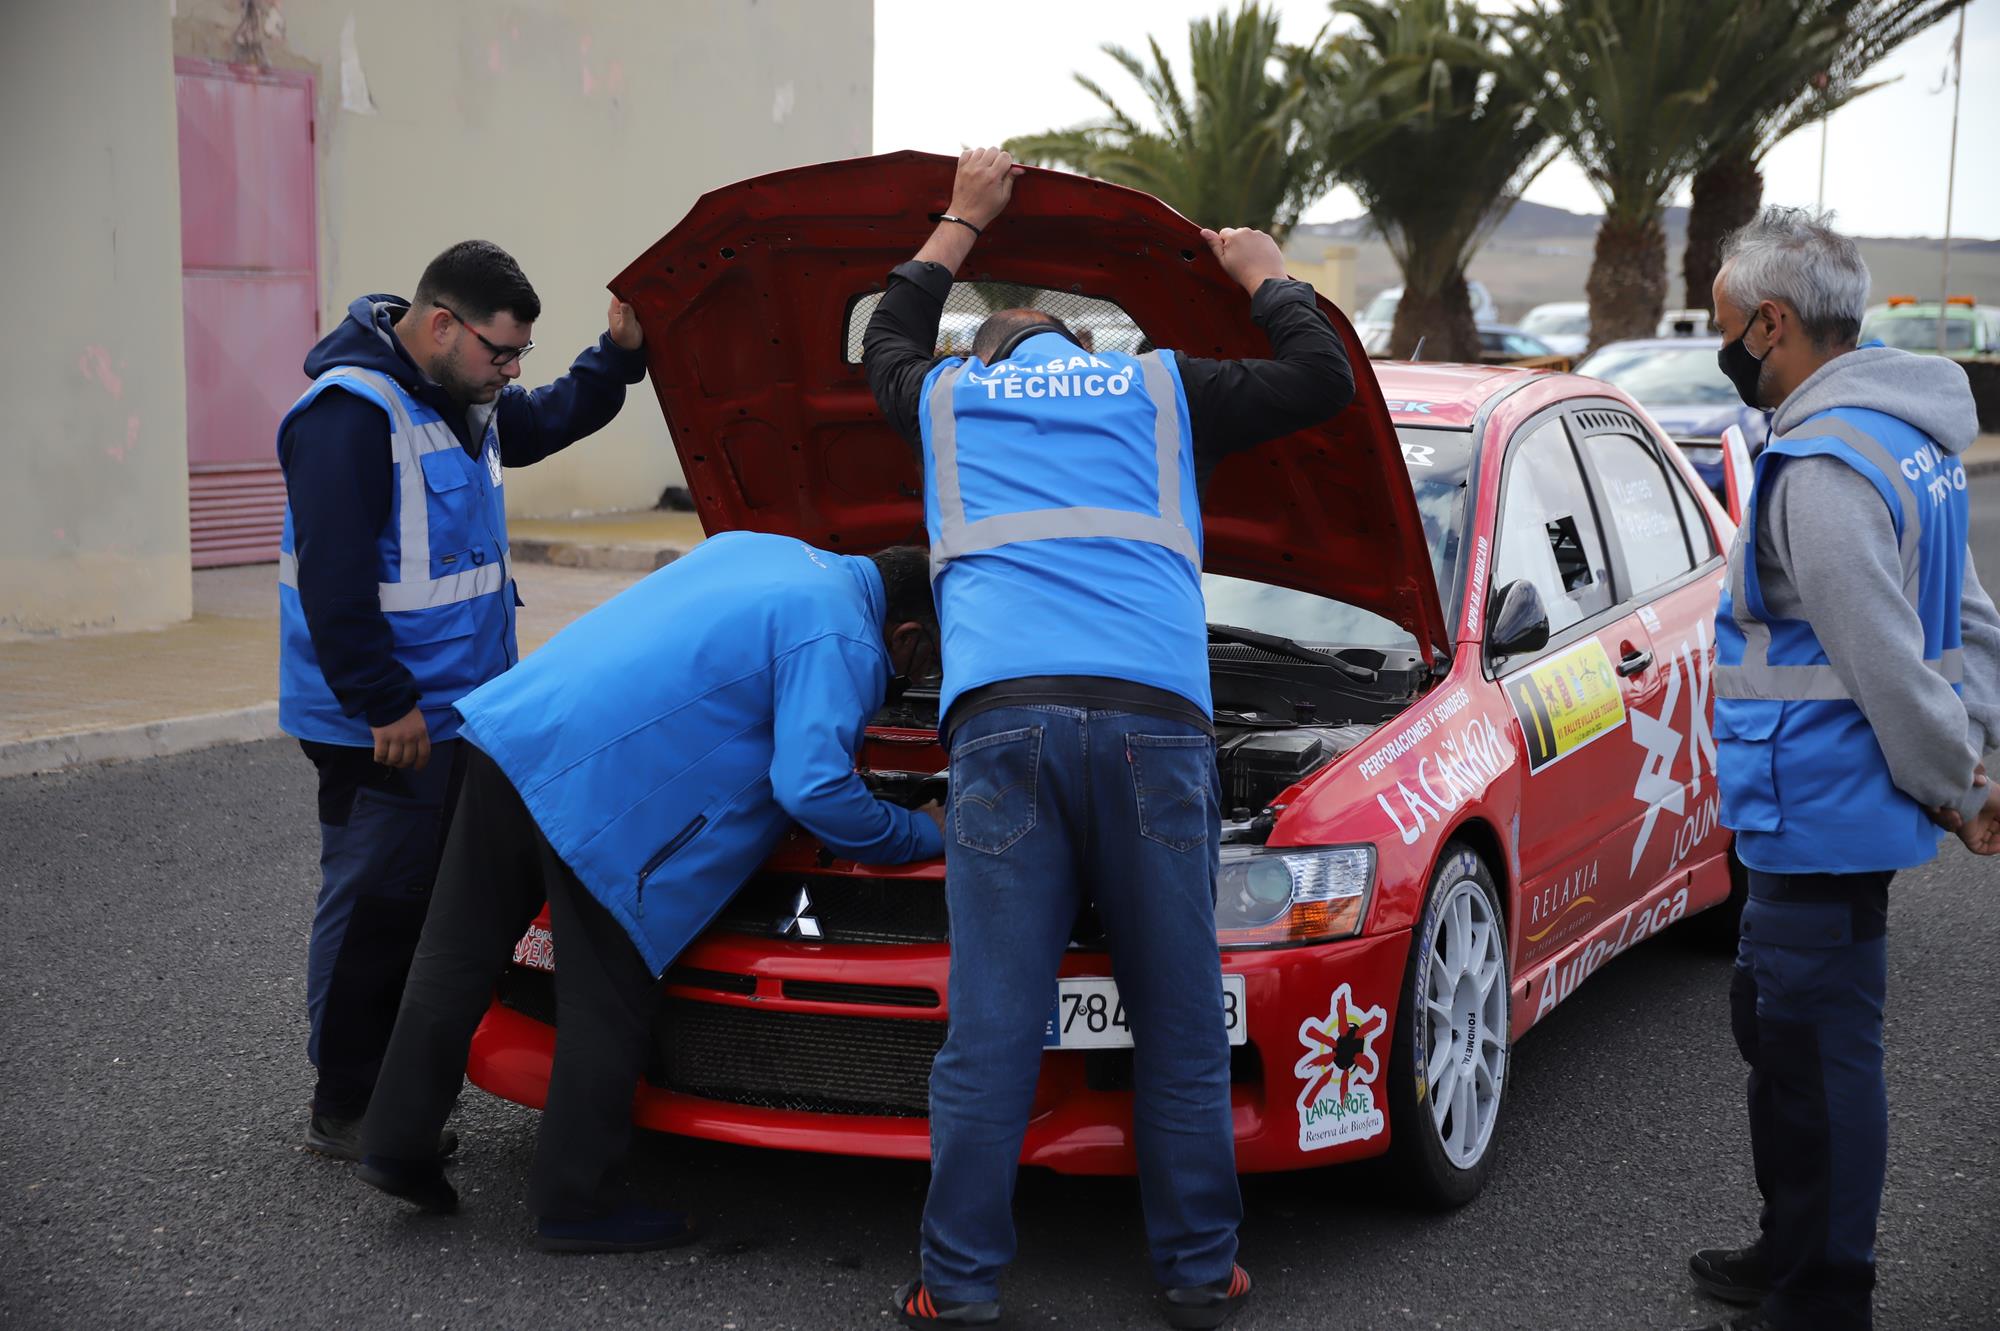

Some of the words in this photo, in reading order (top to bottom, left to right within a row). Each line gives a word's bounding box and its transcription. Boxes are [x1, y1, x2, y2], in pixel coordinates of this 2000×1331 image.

[981, 373, 1130, 399] TÉCNICO
[1358, 716, 1433, 781] PERFORACIONES
[1427, 712, 1438, 728] Y
[1434, 687, 1470, 724] SONDEOS
[1520, 683, 1548, 758] 1
[1376, 779, 1440, 845] LA
[1418, 712, 1507, 811] CAÑADA
[1531, 860, 1599, 924] RELAXIA
[1532, 887, 1689, 1026] Auto-Laca
[1461, 1012, 1476, 1065] FONDMETAL
[1305, 1092, 1370, 1126] LANZAROTE
[1306, 1127, 1337, 1142] Reserva
[1338, 1123, 1349, 1136] de
[1351, 1117, 1379, 1132] Biosfera
